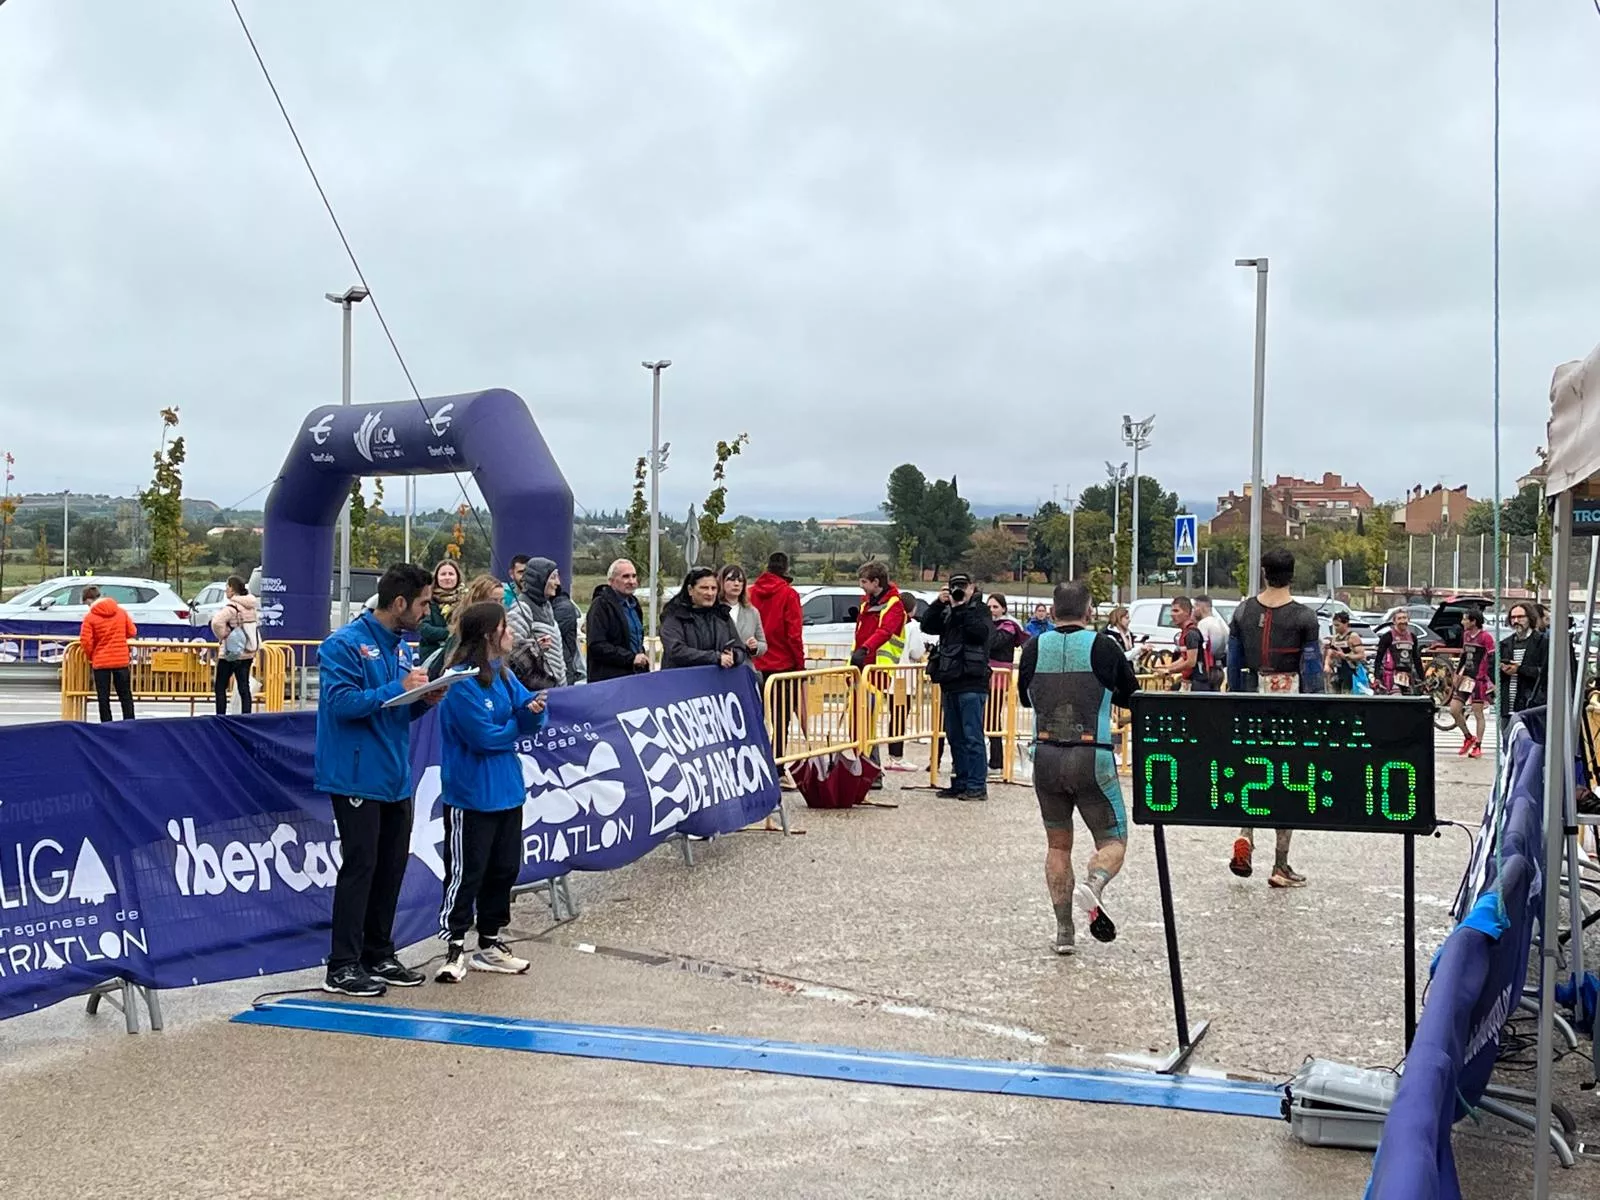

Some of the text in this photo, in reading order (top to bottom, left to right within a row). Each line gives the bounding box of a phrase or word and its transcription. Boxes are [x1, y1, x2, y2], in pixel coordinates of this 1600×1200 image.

[655, 692, 747, 755] GOBIERNO
[681, 757, 711, 814] DE
[522, 814, 634, 865] RIATLON
[0, 910, 139, 938] ragonesa de
